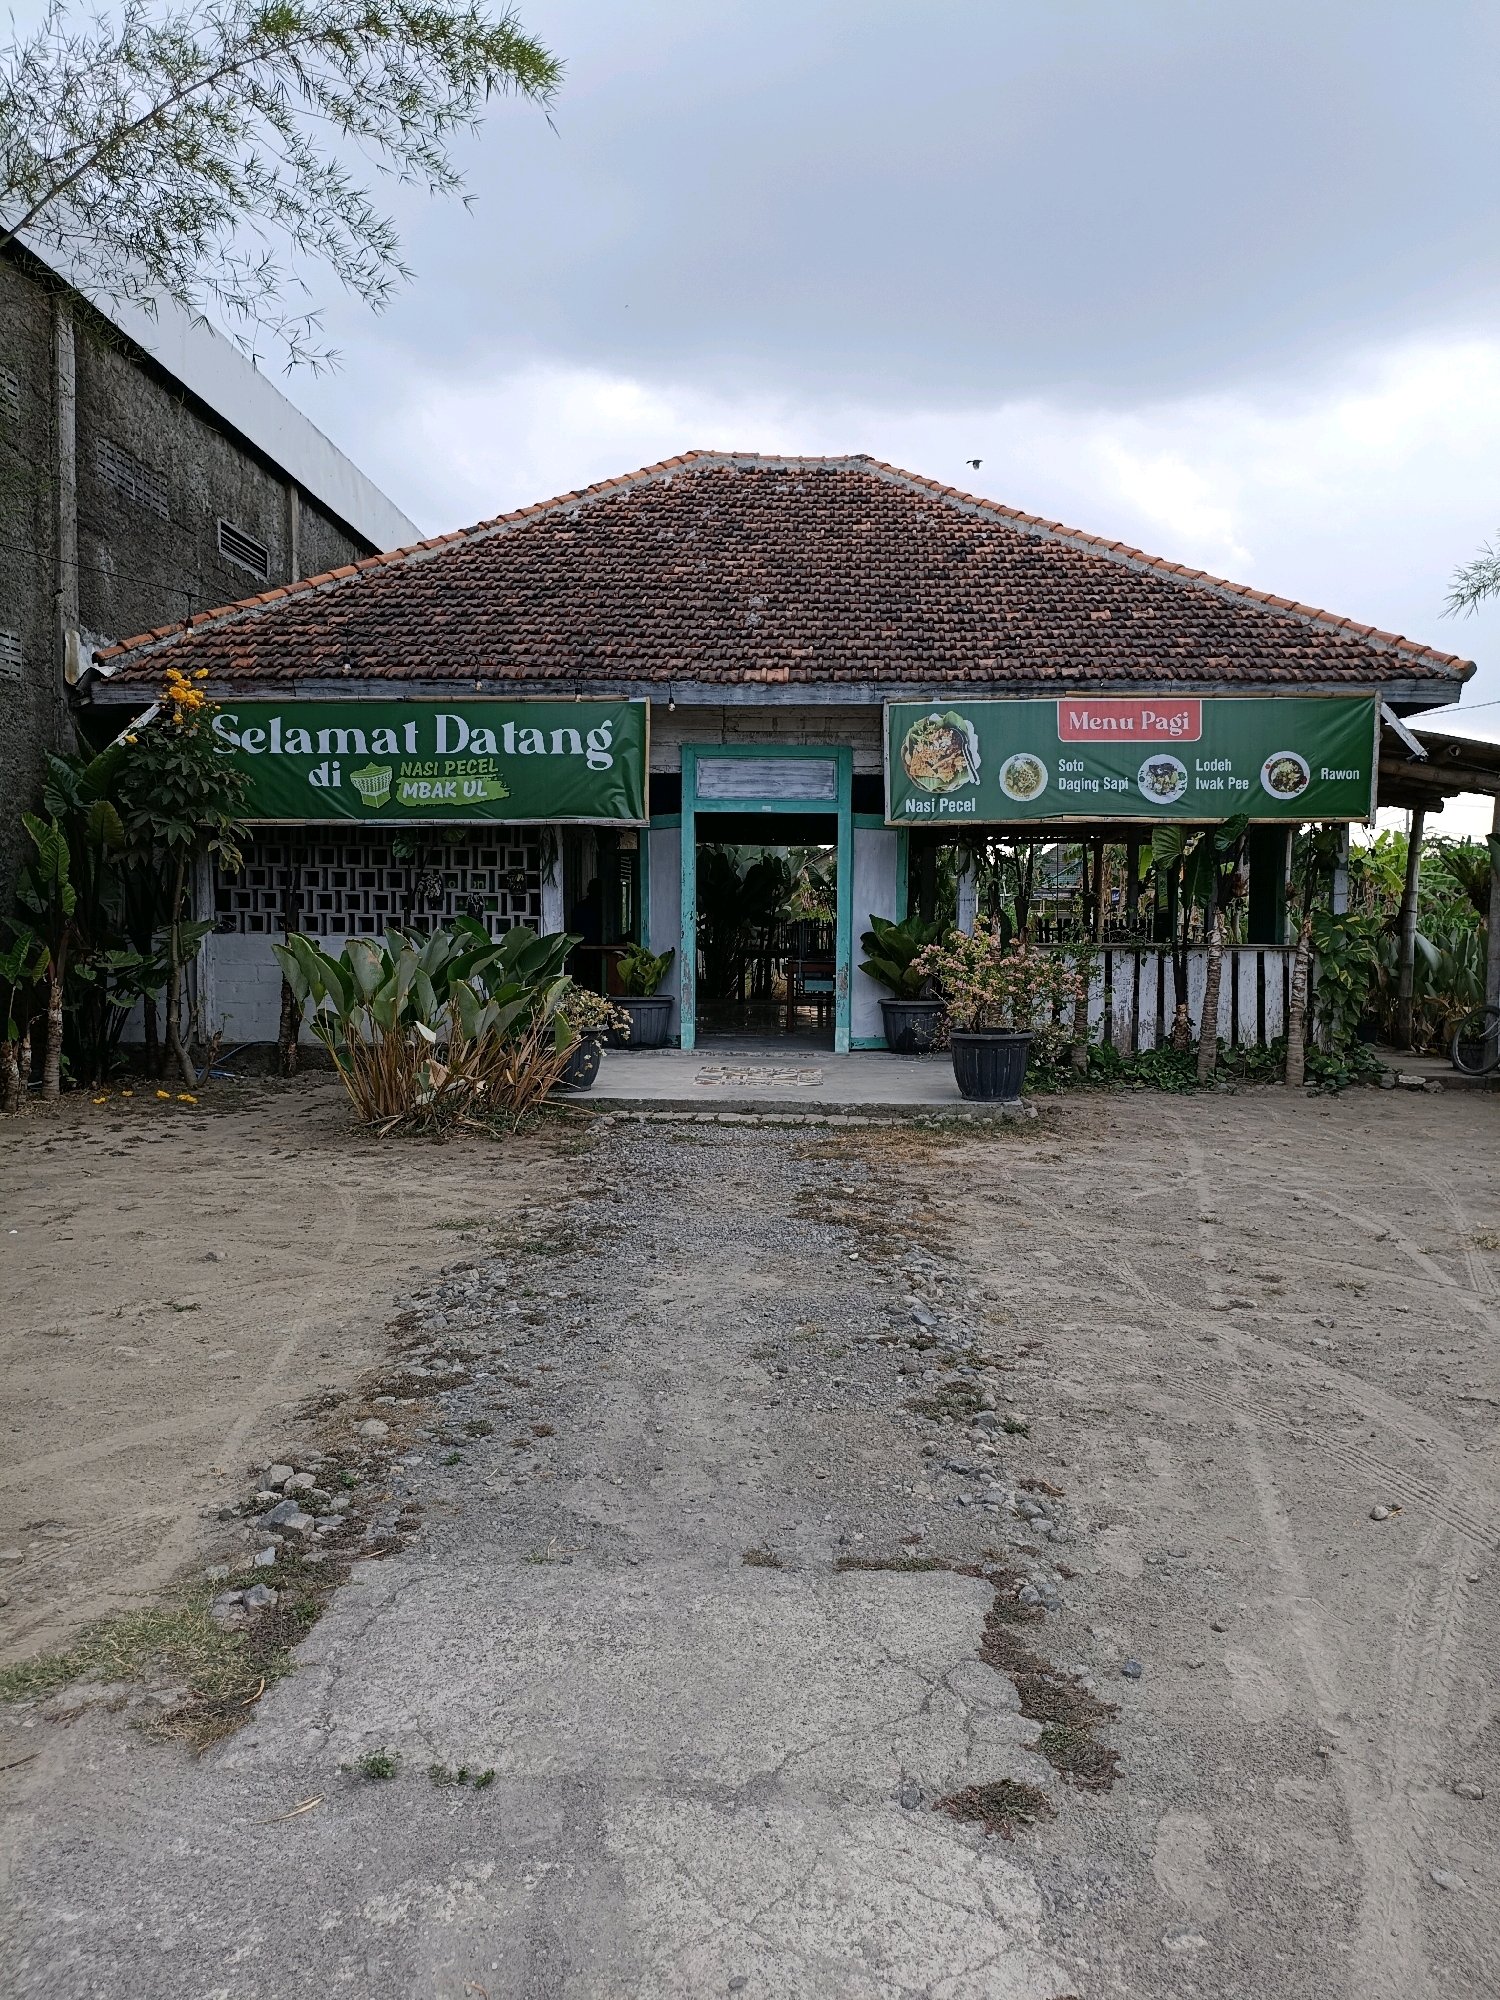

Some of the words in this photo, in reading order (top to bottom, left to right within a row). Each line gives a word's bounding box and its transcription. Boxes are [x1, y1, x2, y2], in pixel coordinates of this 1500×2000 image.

[1069, 711, 1134, 730] Menu
[1141, 711, 1189, 736] Pagi
[211, 714, 419, 754] Selamat
[434, 714, 614, 770] Datang
[400, 762, 439, 776] NASI
[445, 758, 499, 775] PECEL
[1058, 758, 1084, 772] Soto
[1196, 758, 1232, 772] Lodeh
[308, 760, 342, 787] di
[1320, 767, 1360, 780] Rawon
[402, 781, 457, 799] MBAK
[463, 780, 488, 797] UL
[1058, 778, 1100, 793] Daging
[1103, 777, 1129, 793] Sapi
[1195, 776, 1224, 790] Iwak
[1228, 777, 1249, 790] Pee
[905, 798, 935, 813] Nasi
[940, 797, 976, 813] Pecel
